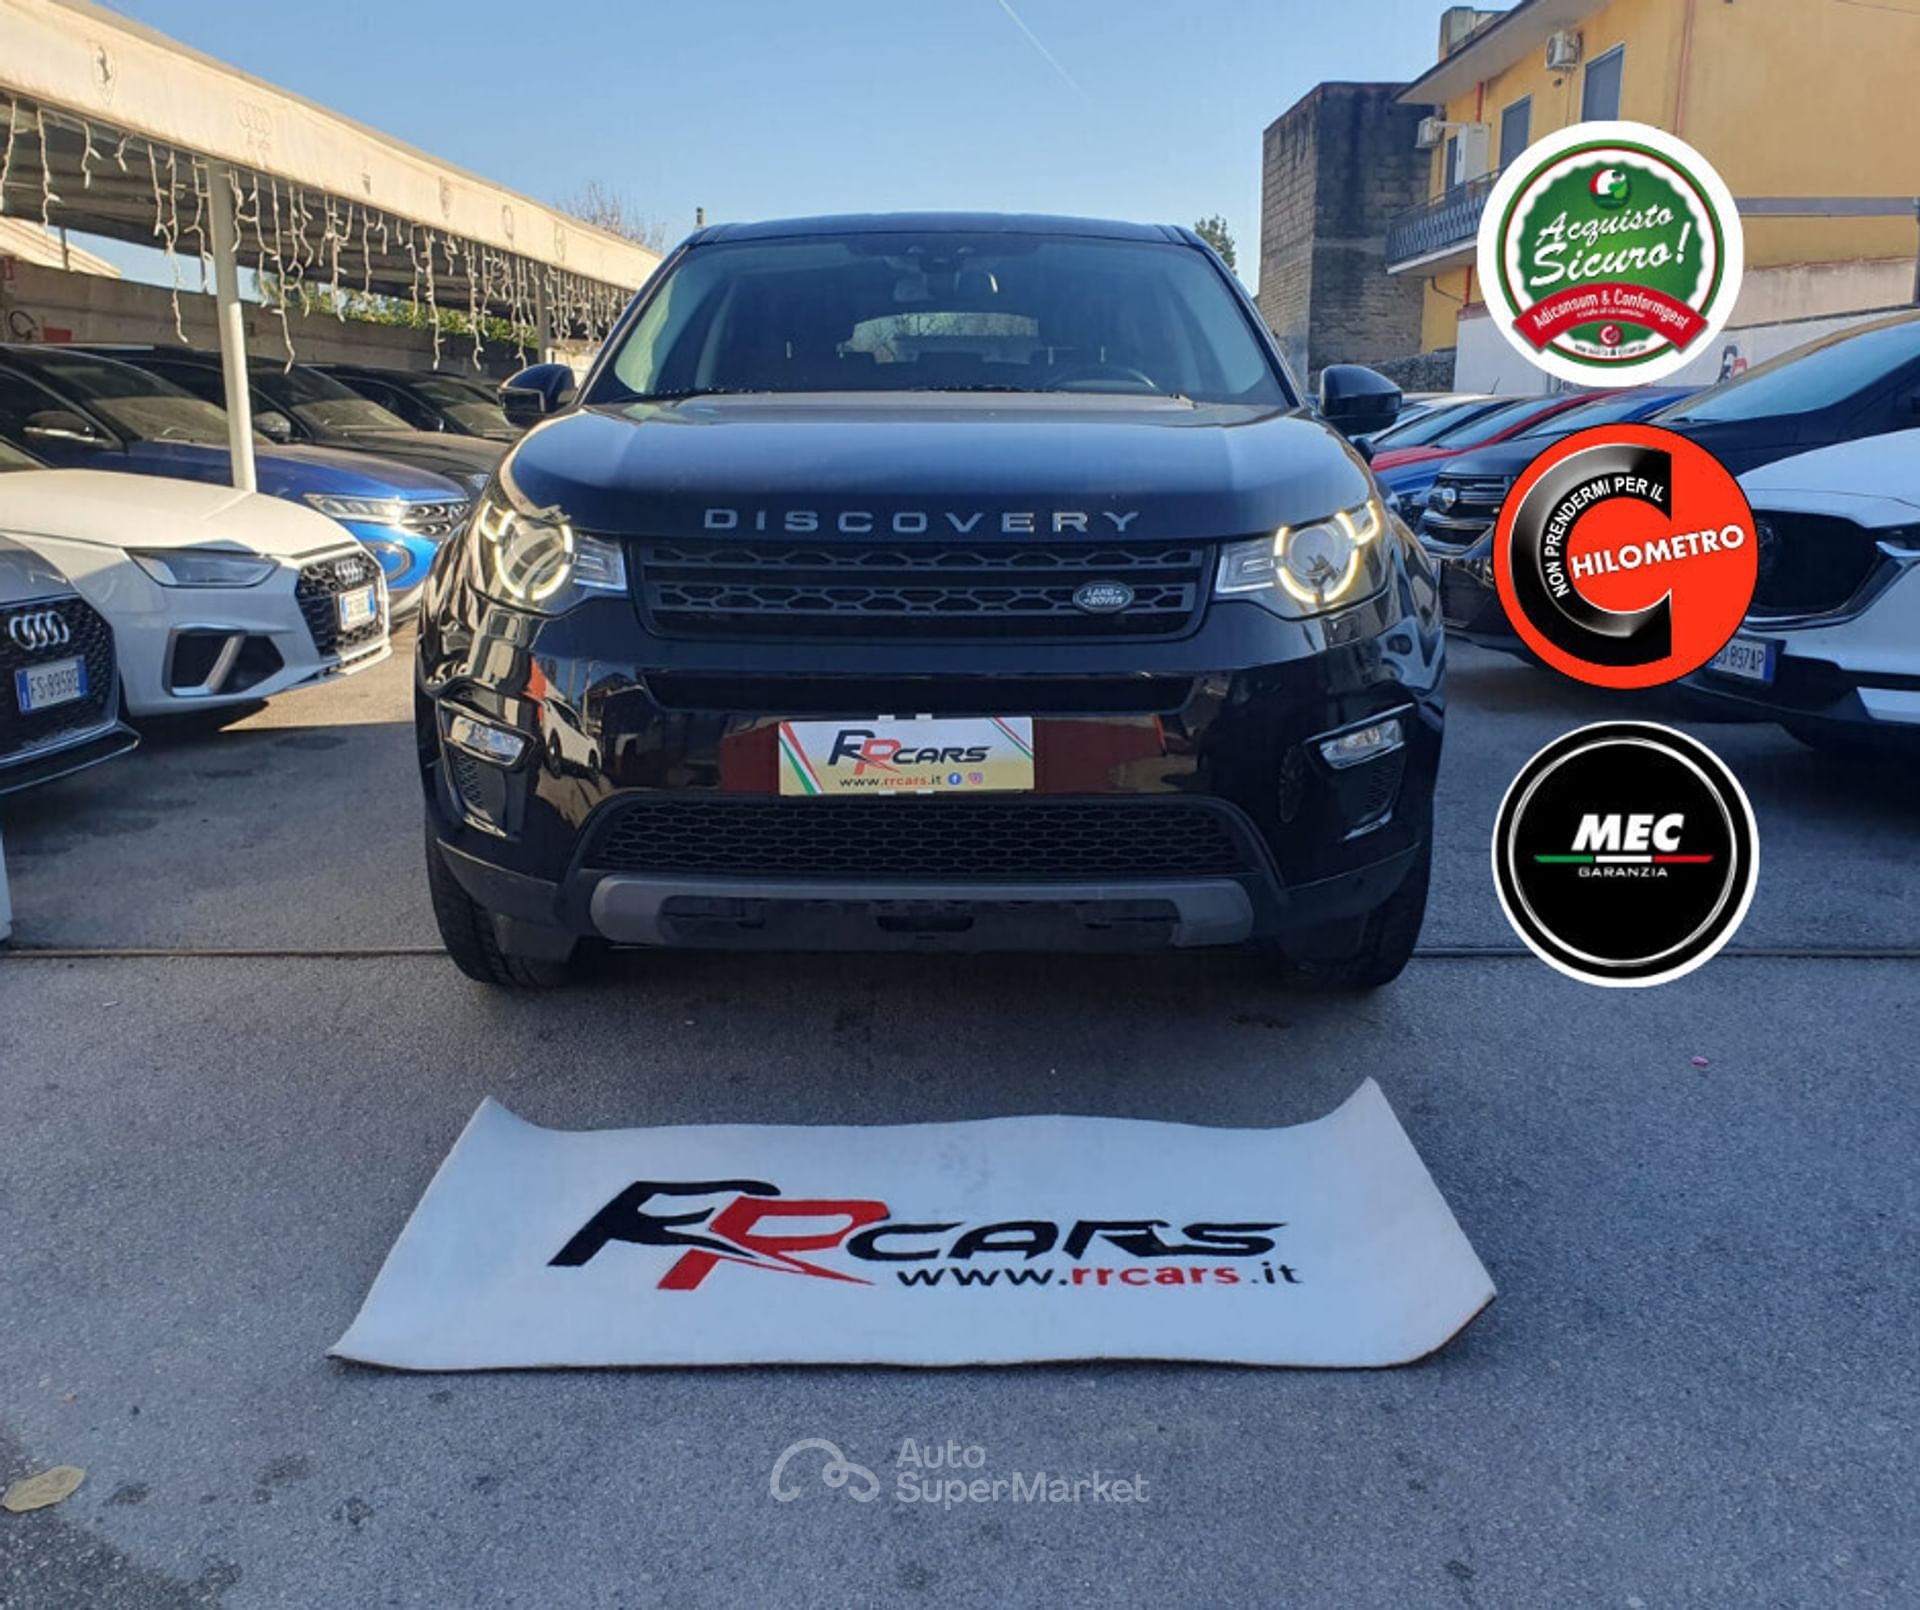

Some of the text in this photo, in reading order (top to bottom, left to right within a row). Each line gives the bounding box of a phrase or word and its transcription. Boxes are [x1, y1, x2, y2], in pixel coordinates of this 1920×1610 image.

[704, 508, 1140, 533] DISCOVERY
[839, 775, 942, 787] www.rrcars.it
[897, 1260, 1302, 1286] www.rrcars.it
